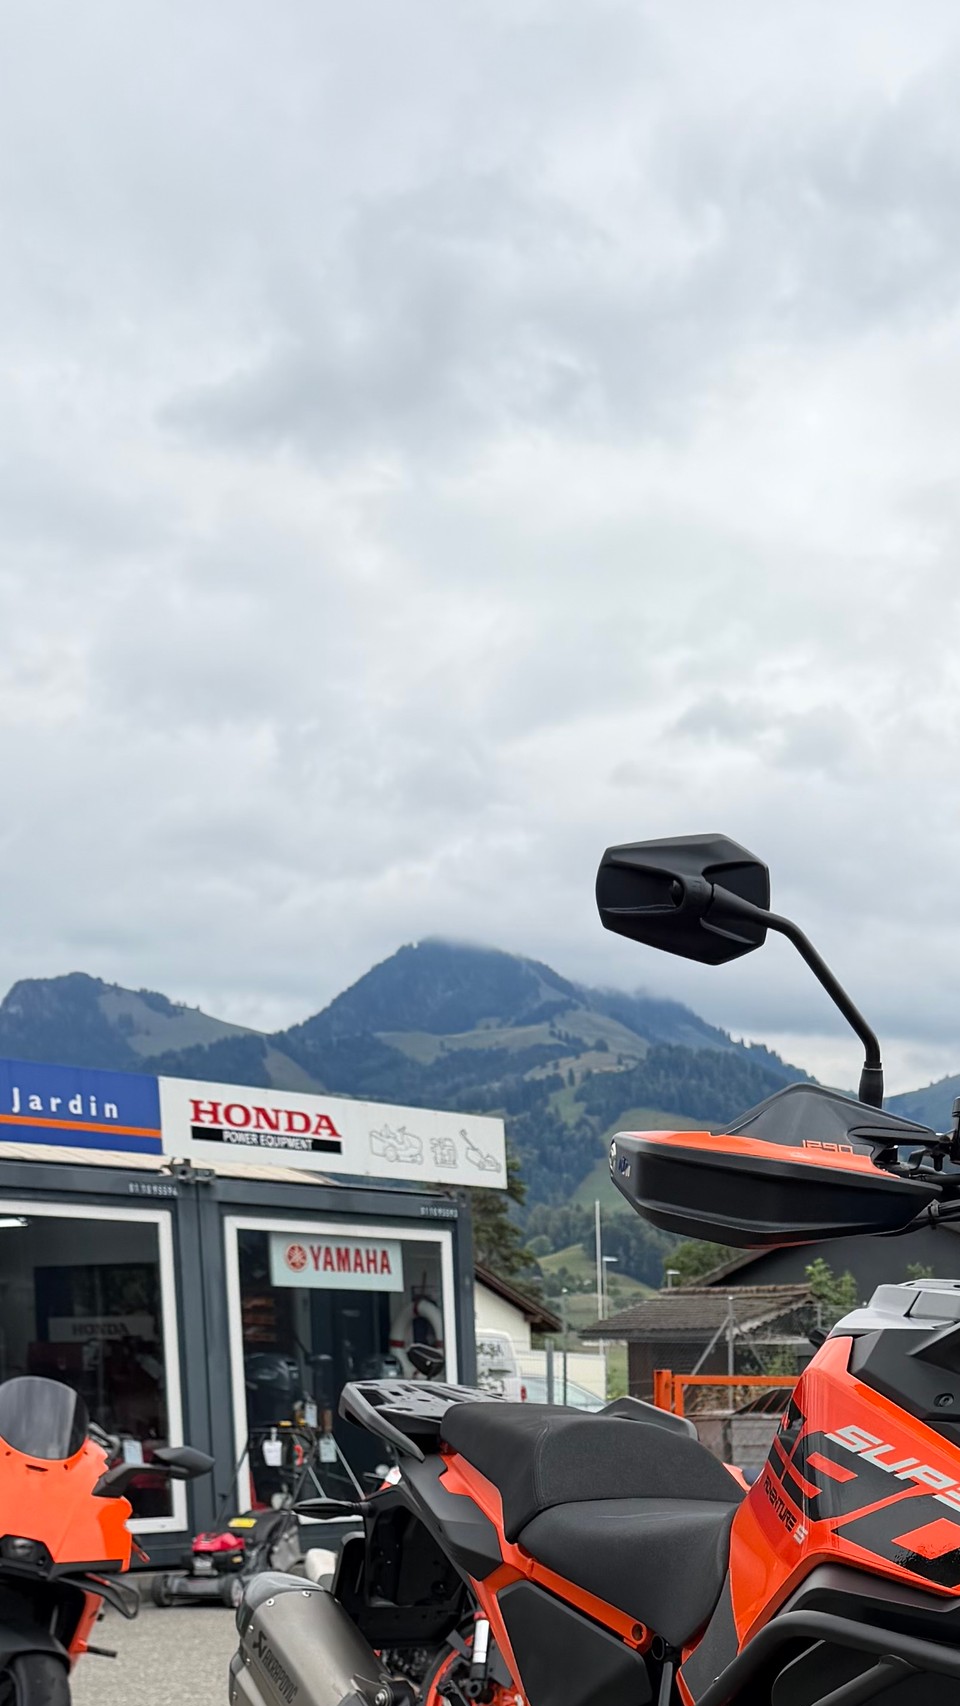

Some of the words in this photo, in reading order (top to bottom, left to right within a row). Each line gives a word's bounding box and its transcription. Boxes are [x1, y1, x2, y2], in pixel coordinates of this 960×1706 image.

[12, 1086, 119, 1119] Jardin
[189, 1099, 342, 1138] HONDA
[222, 1130, 259, 1146] POWER
[260, 1135, 314, 1151] EQUIPMENT
[802, 1139, 853, 1155] 1290
[309, 1244, 391, 1275] YAMAHA
